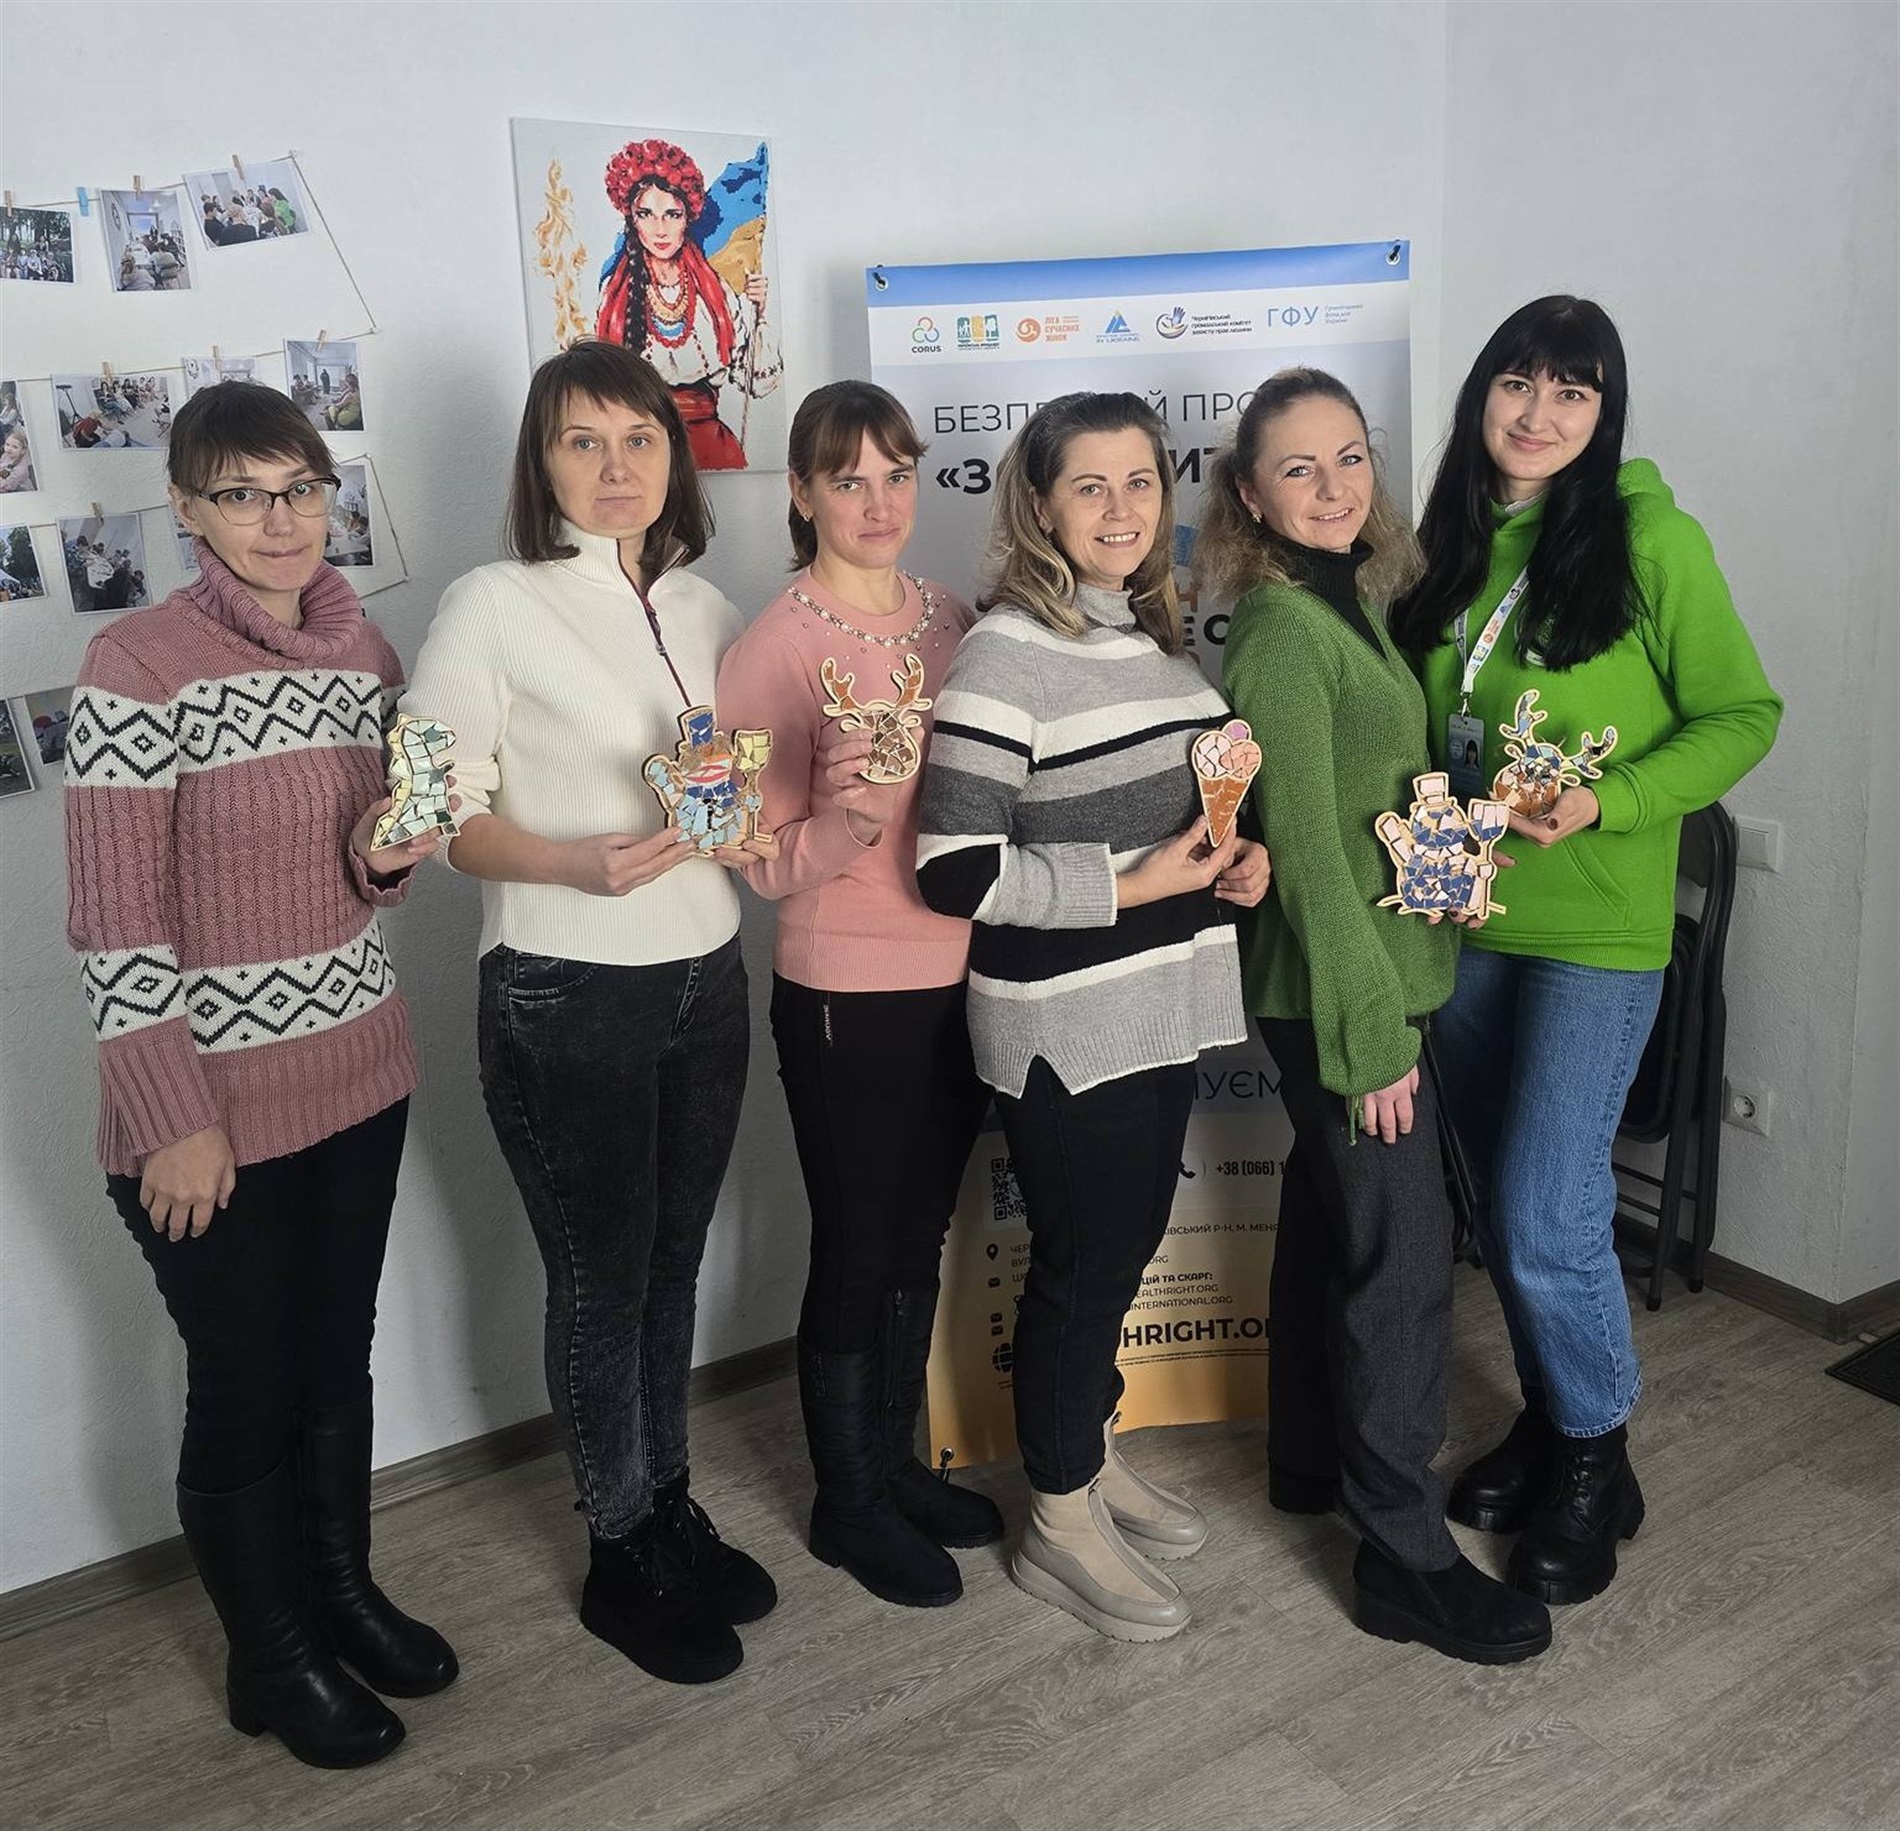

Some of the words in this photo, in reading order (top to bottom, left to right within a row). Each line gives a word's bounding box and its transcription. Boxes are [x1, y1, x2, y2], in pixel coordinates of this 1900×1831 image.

[1268, 306, 1319, 327] ГФУ
[912, 345, 942, 353] CORUS
[1195, 1071, 1283, 1100] УЄМ
[1217, 1161, 1239, 1176] +38
[1242, 1160, 1275, 1176] (066)
[1010, 1243, 1030, 1253] ЧЕР
[1164, 1223, 1210, 1235] ІВСЬКИЙ
[1142, 1274, 1159, 1286] ЦІЙ
[1162, 1273, 1175, 1283] ТА
[1136, 1284, 1219, 1298] EALTHRIGHT.ORG
[1131, 1296, 1233, 1311] INTERNATIONAL.ORG
[1123, 1317, 1269, 1348] HRIGHT.O
